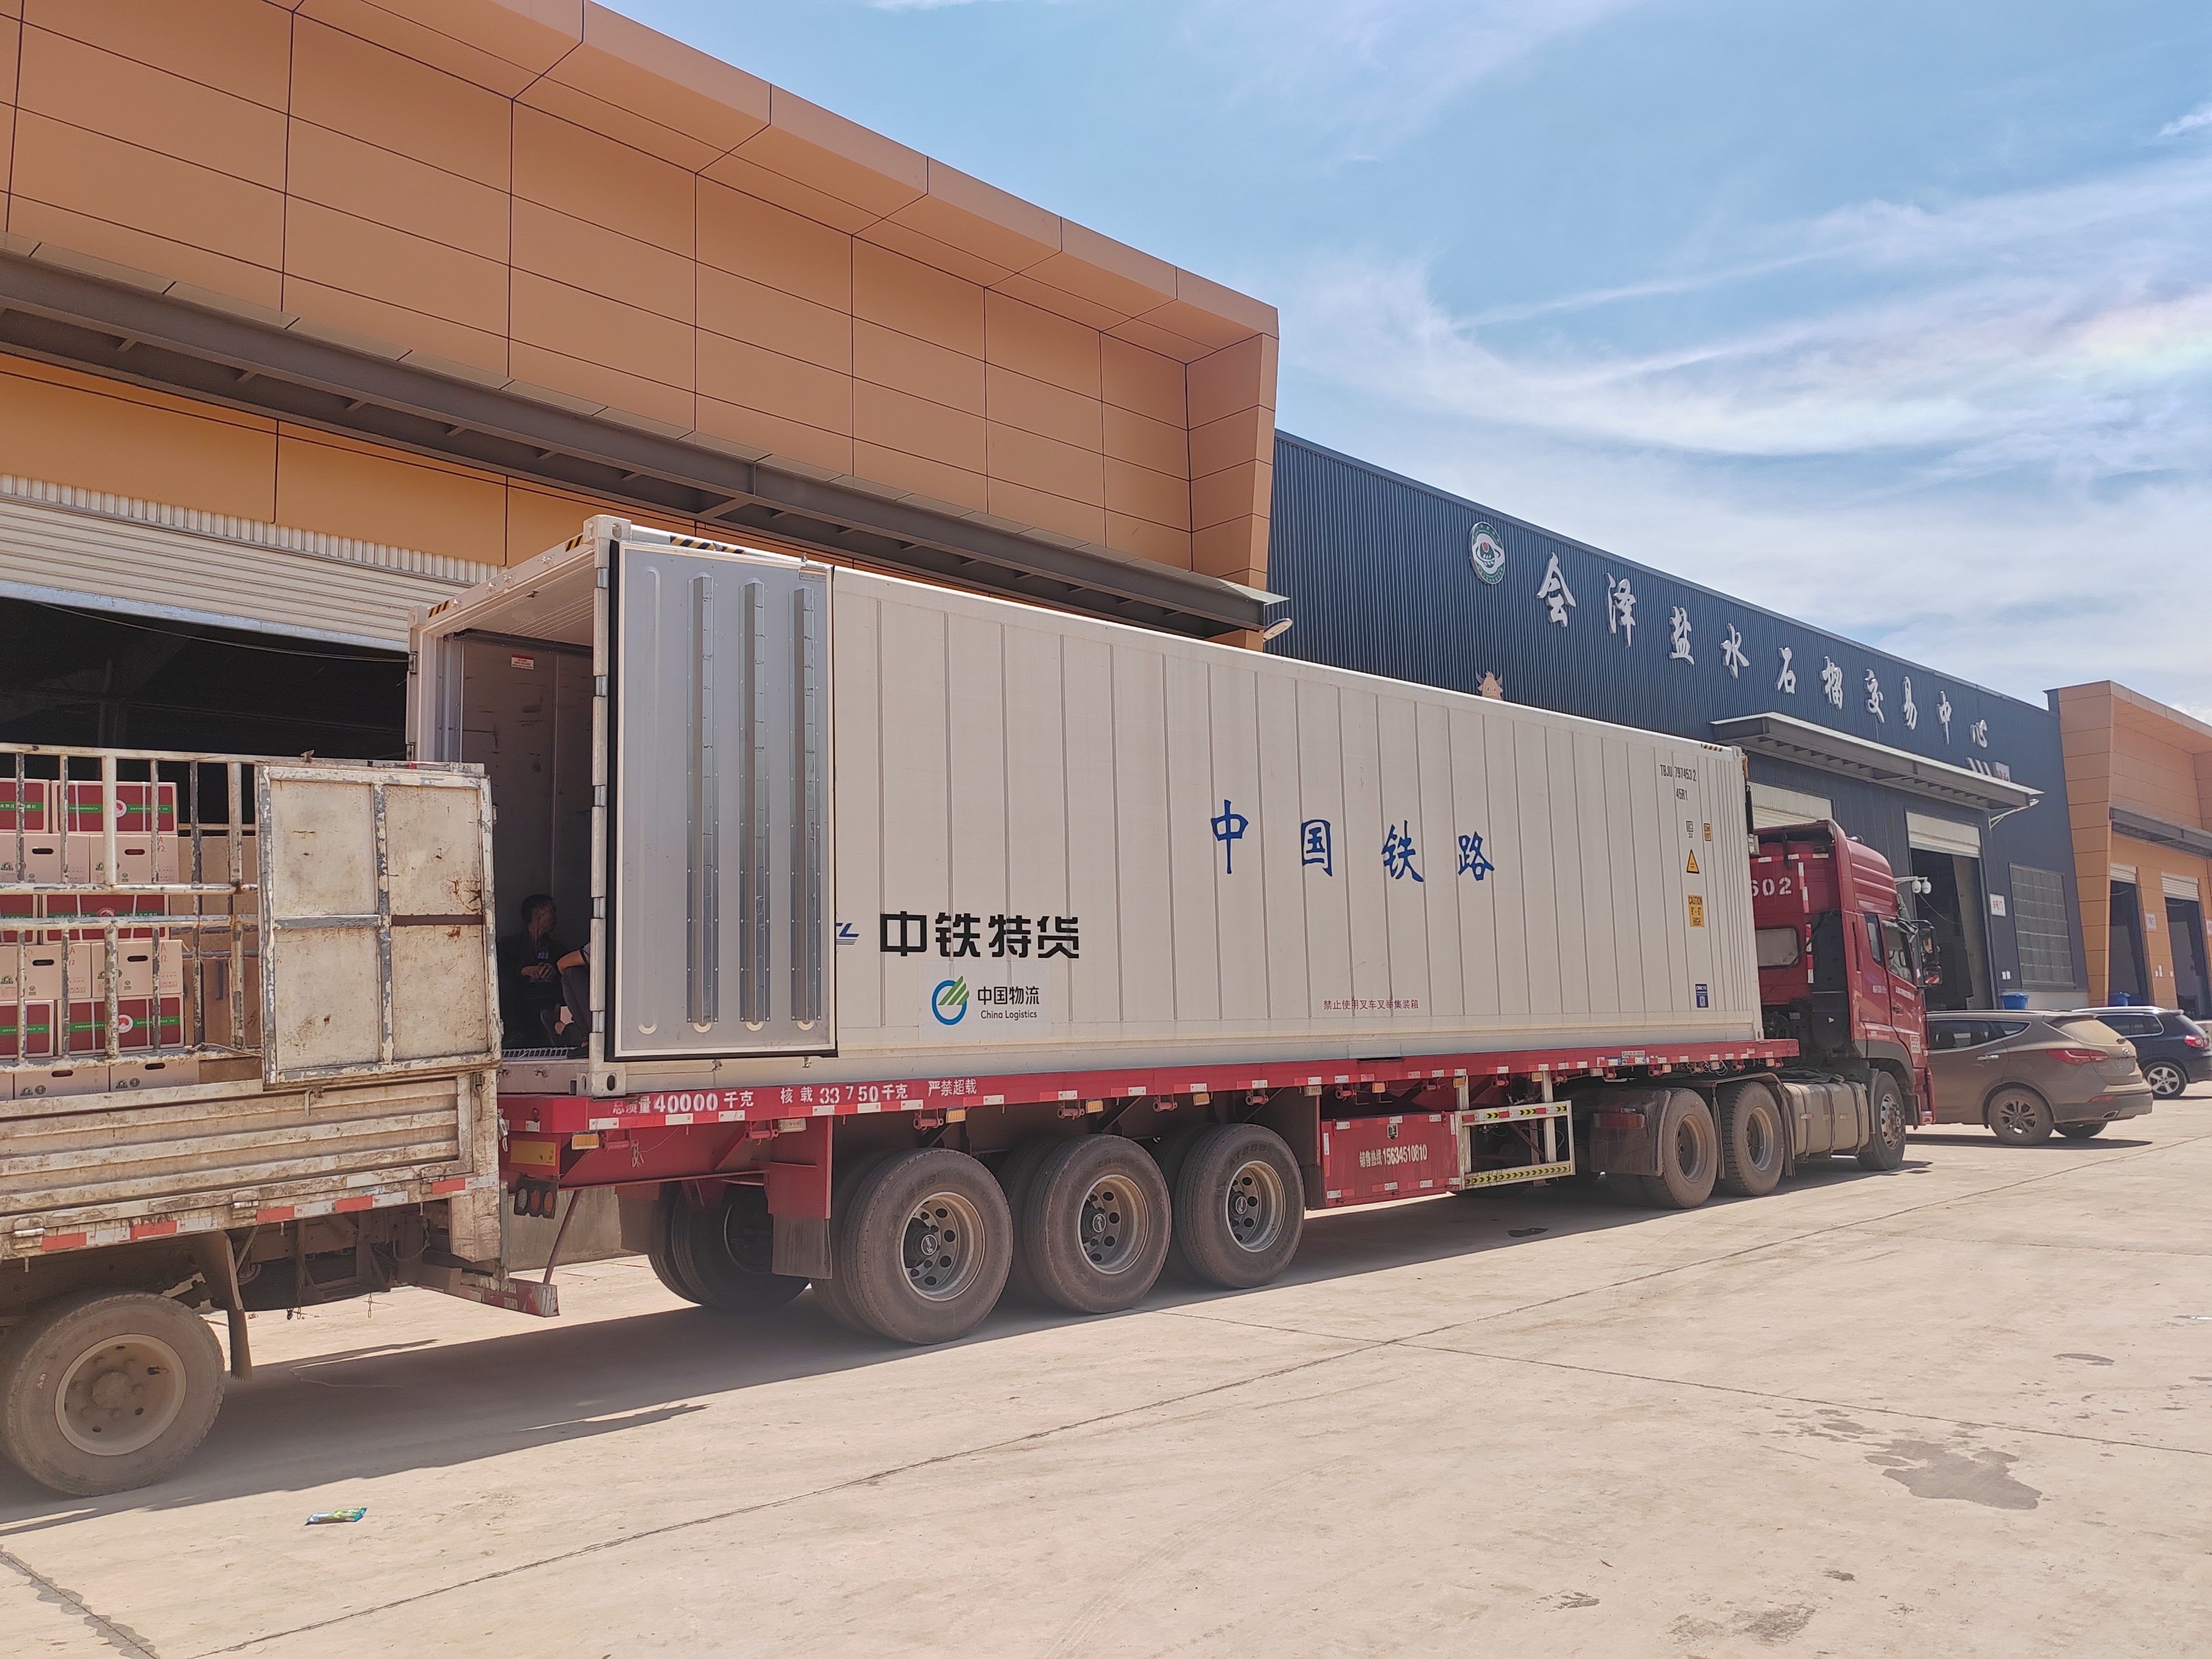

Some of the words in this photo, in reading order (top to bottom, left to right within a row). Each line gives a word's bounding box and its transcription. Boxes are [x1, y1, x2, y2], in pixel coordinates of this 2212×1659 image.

[1537, 552, 1987, 748] 会泽盐水石榴交易中心
[1660, 764, 1673, 777] TBJU
[1676, 788, 1688, 801] 45R1
[1210, 799, 1494, 882] 中国铁路
[880, 911, 1079, 959] 中铁特货
[978, 986, 1040, 1005] 中国物流
[1324, 999, 1419, 1010] 禁止使用叉车叉举集装箱
[981, 1010, 1003, 1019] China
[1005, 1010, 1037, 1021] Logistics
[928, 1078, 977, 1097] 严禁超载
